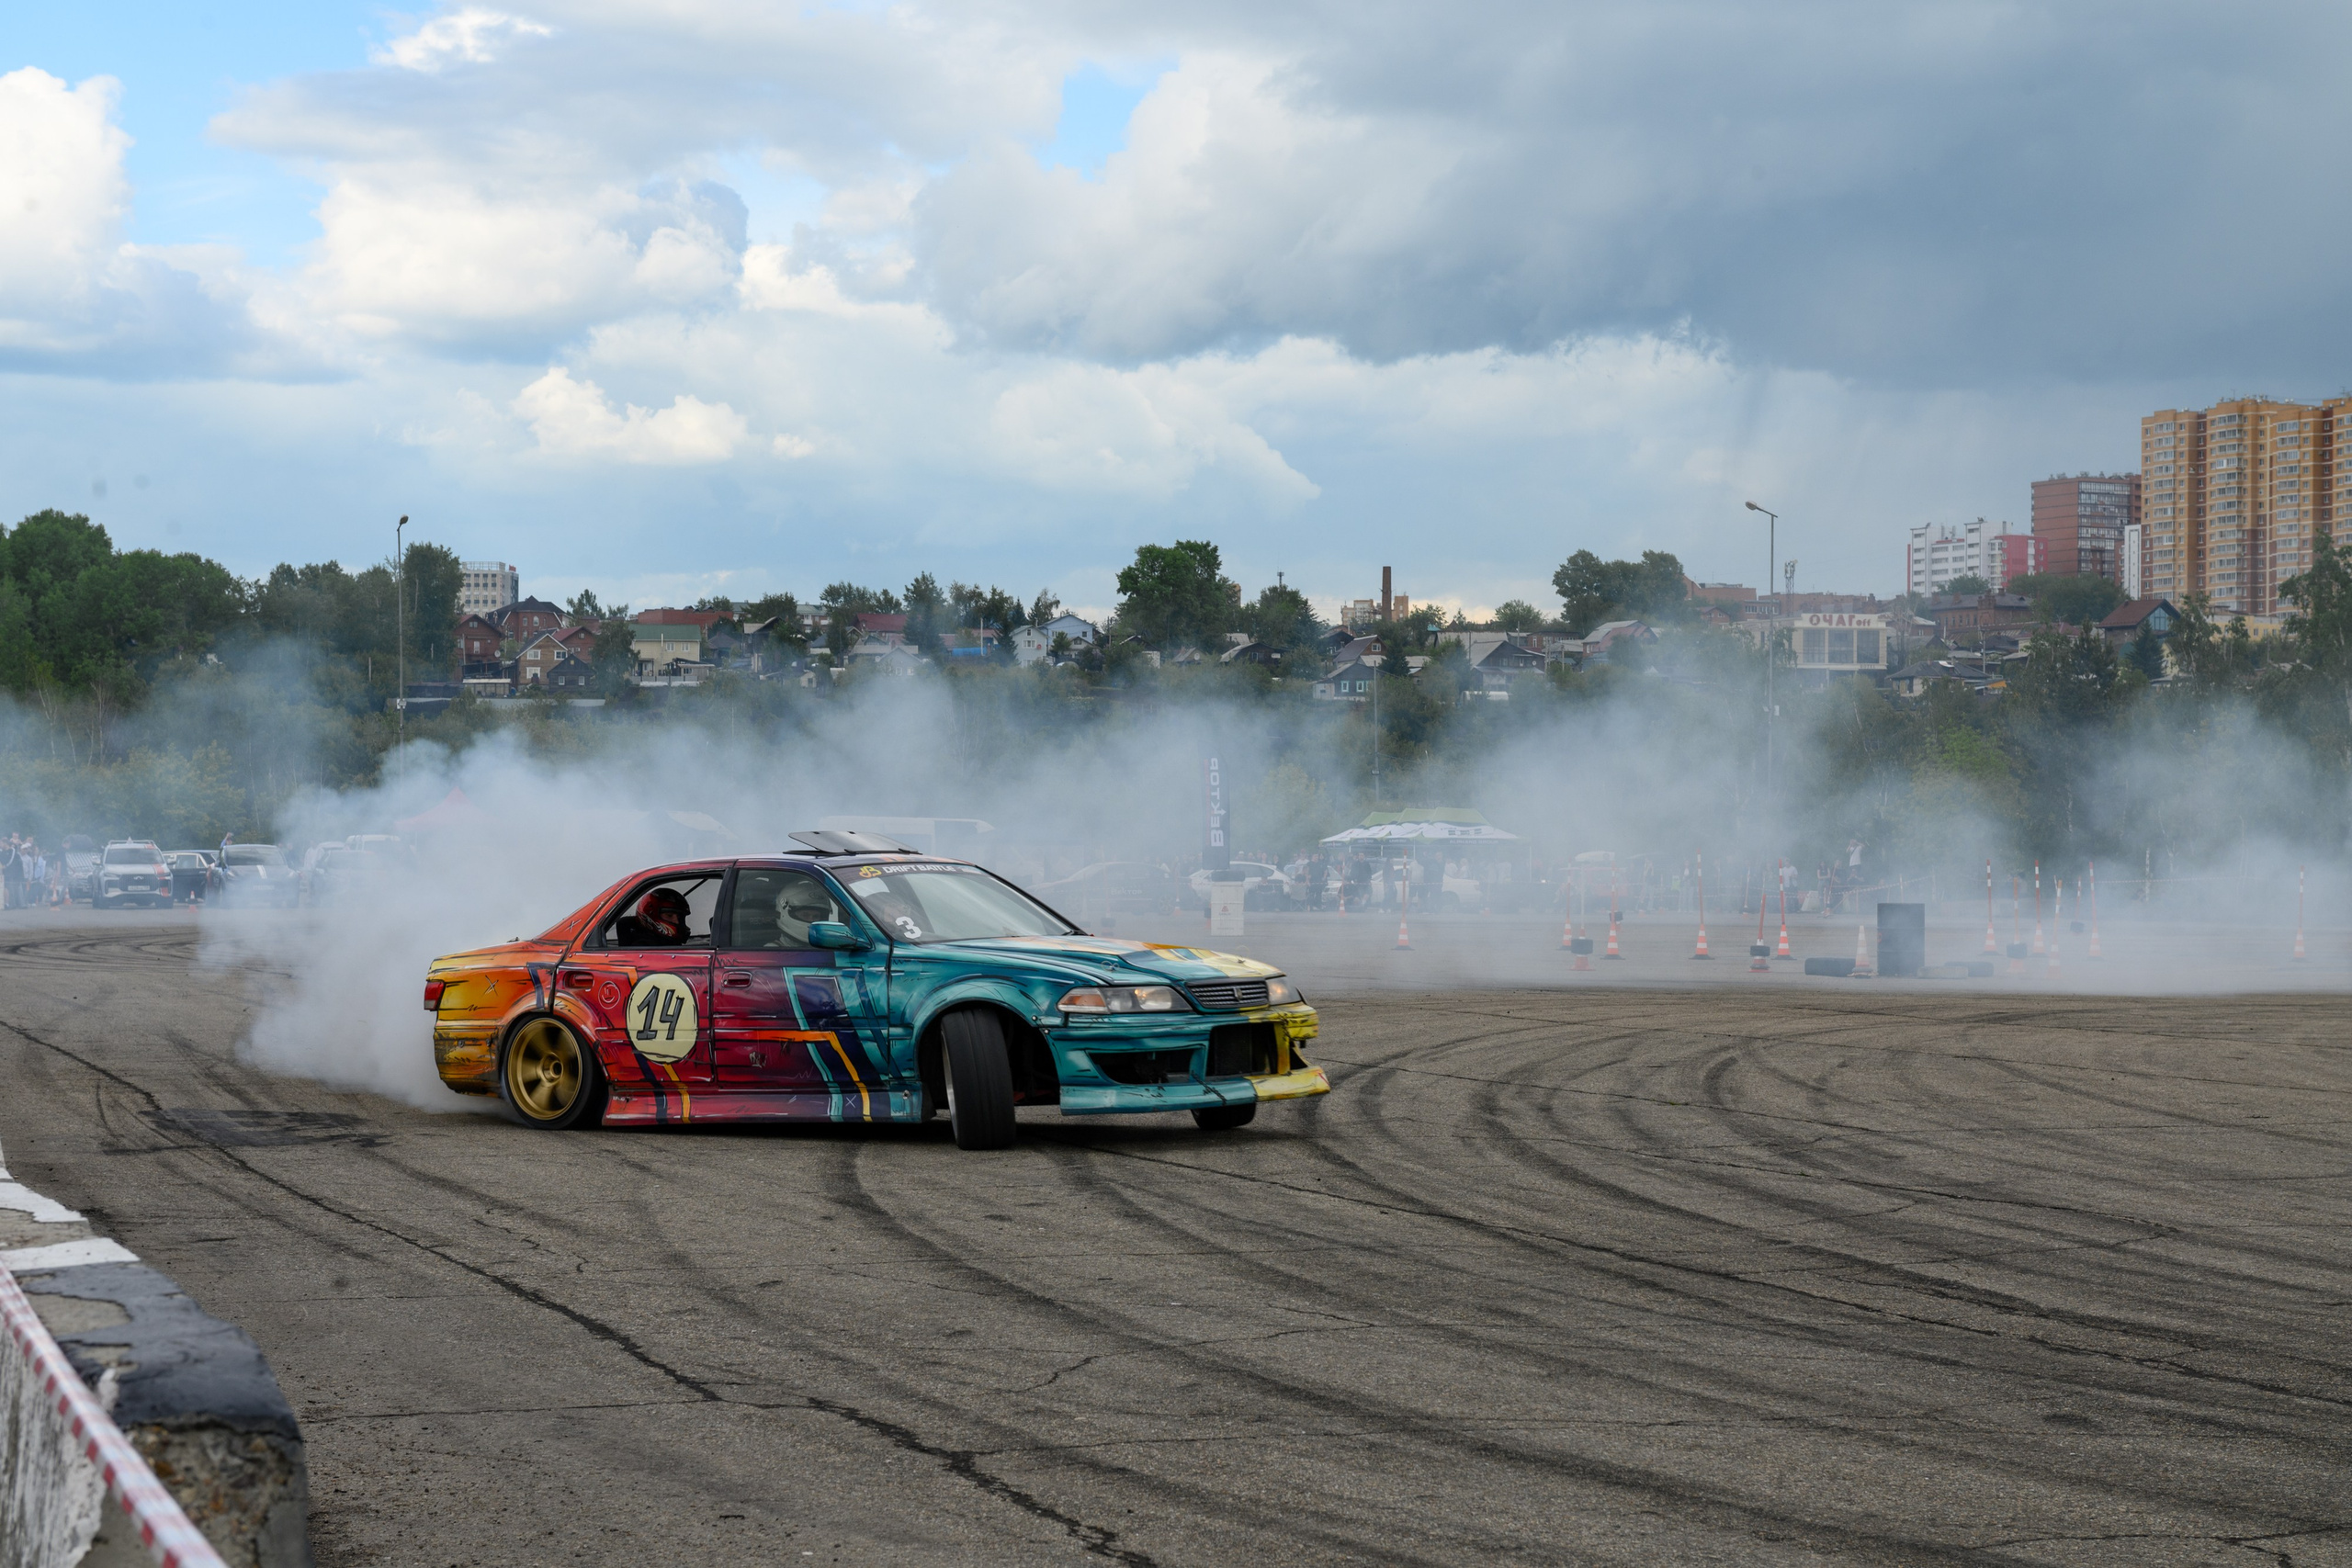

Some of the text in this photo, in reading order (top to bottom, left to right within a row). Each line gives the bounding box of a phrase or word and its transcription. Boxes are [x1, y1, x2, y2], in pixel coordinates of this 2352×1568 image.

[882, 865, 917, 874] DRIFT
[895, 916, 922, 939] 3
[636, 985, 685, 1041] 14
